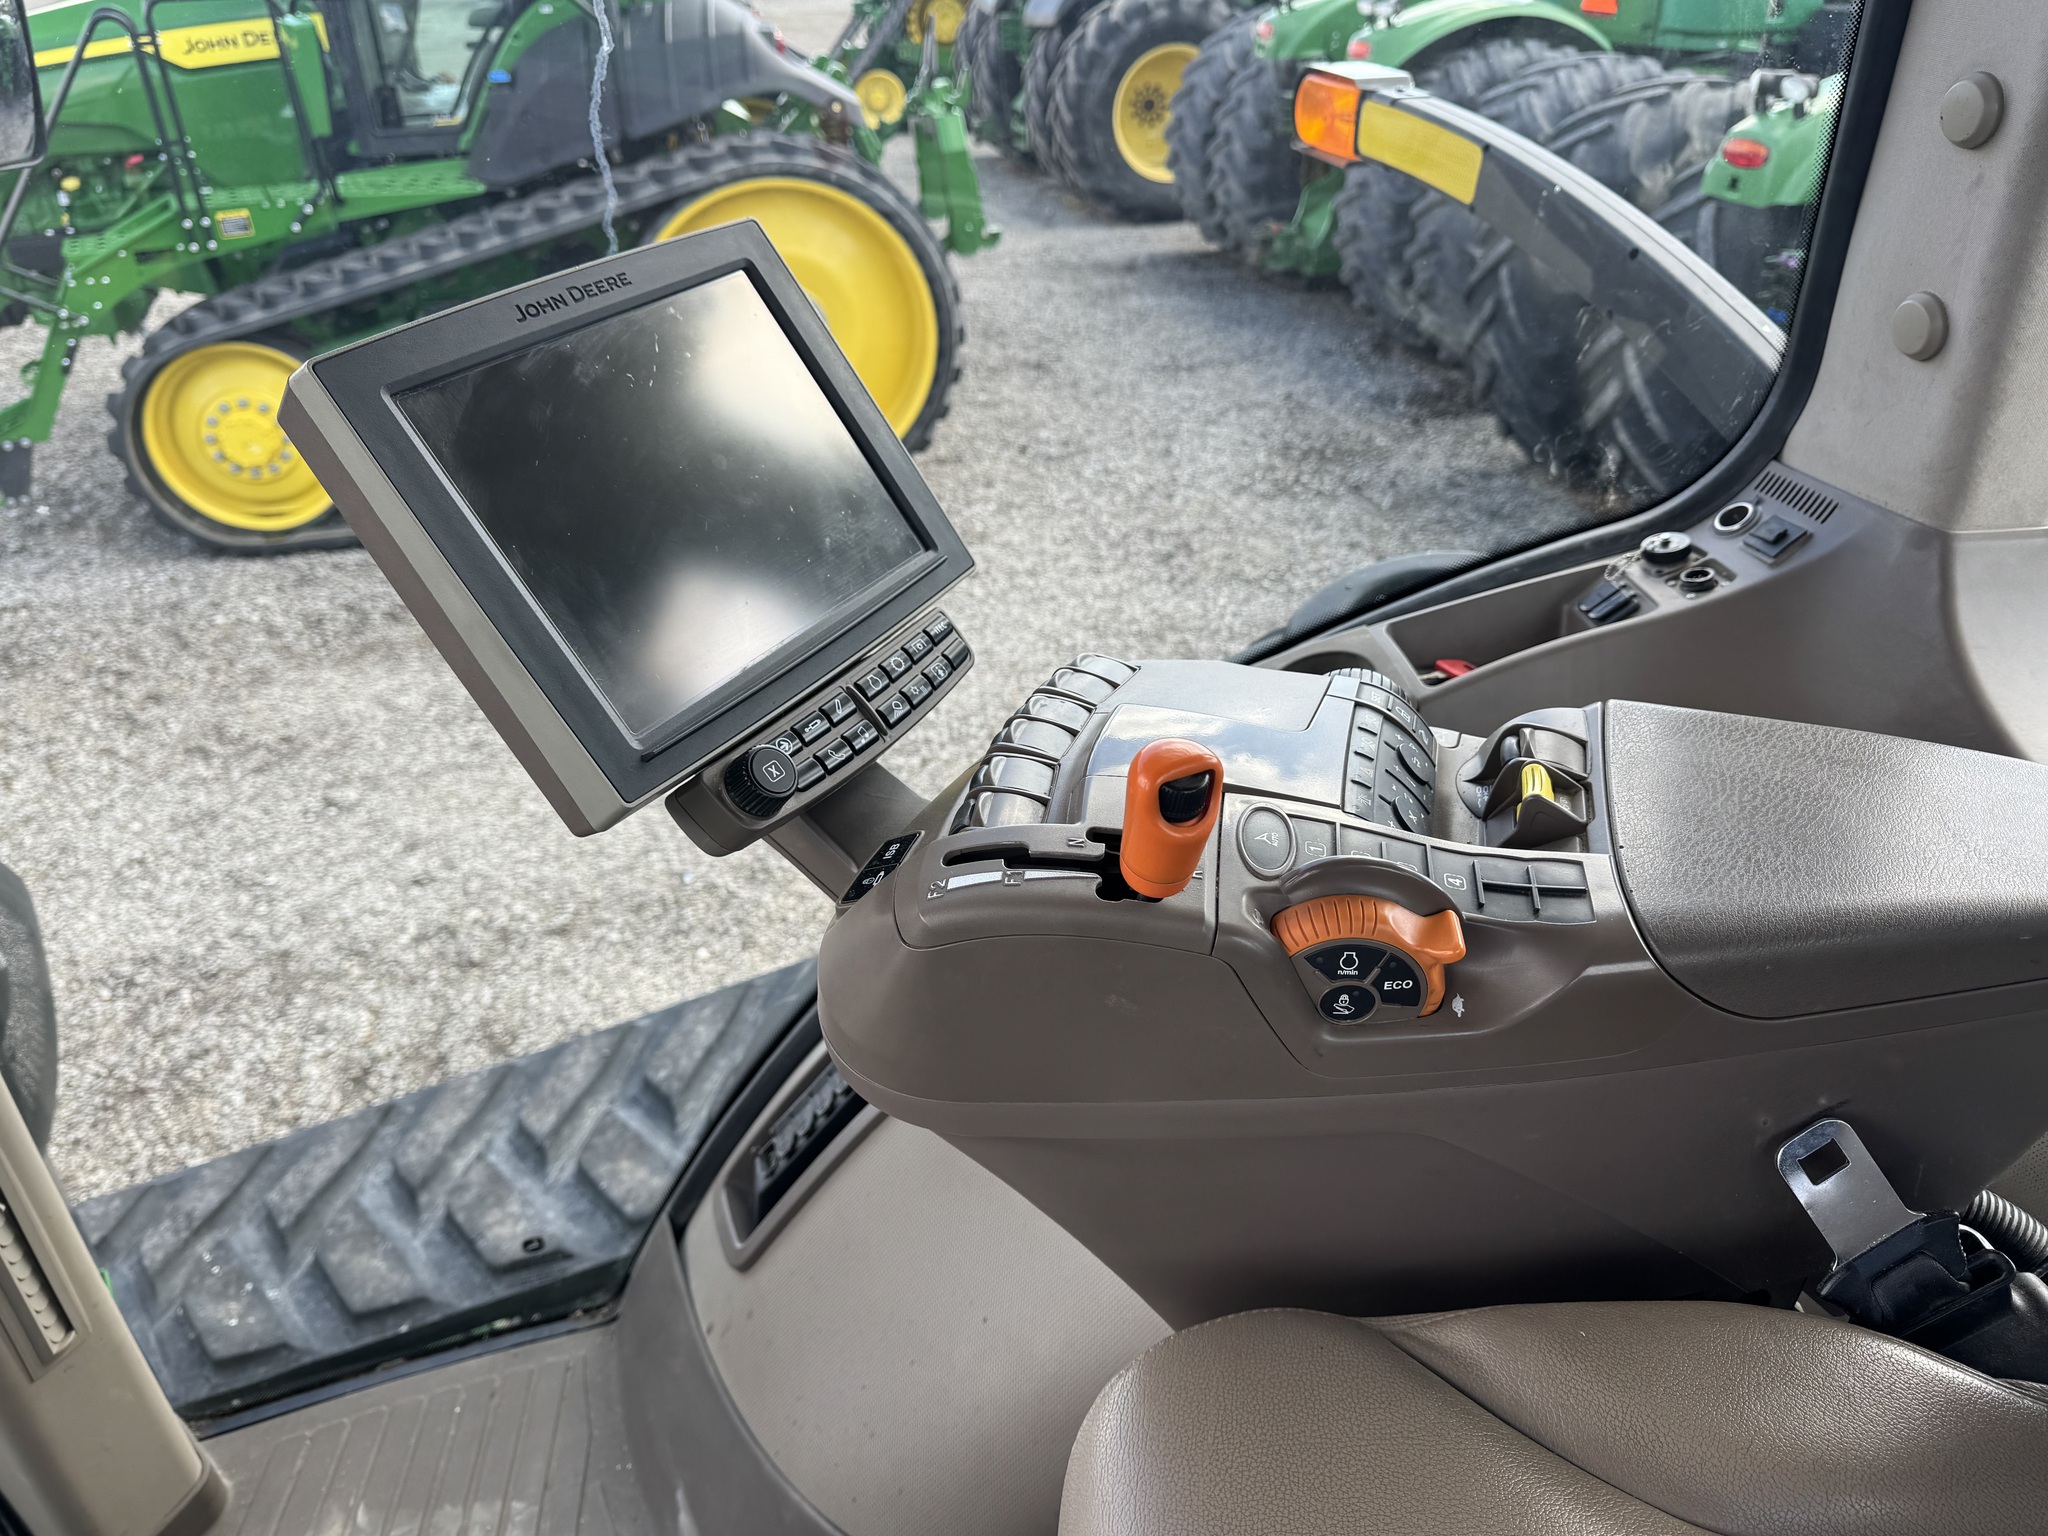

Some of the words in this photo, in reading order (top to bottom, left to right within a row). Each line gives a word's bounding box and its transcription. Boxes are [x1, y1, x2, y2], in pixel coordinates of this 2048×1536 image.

[183, 33, 238, 55] JOHN
[241, 30, 271, 48] DE
[514, 294, 569, 323] JOHN
[565, 272, 633, 304] DEERE
[1067, 837, 1085, 848] N
[1004, 870, 1024, 886] F1
[927, 878, 947, 900] F2
[1383, 980, 1413, 991] ECO
